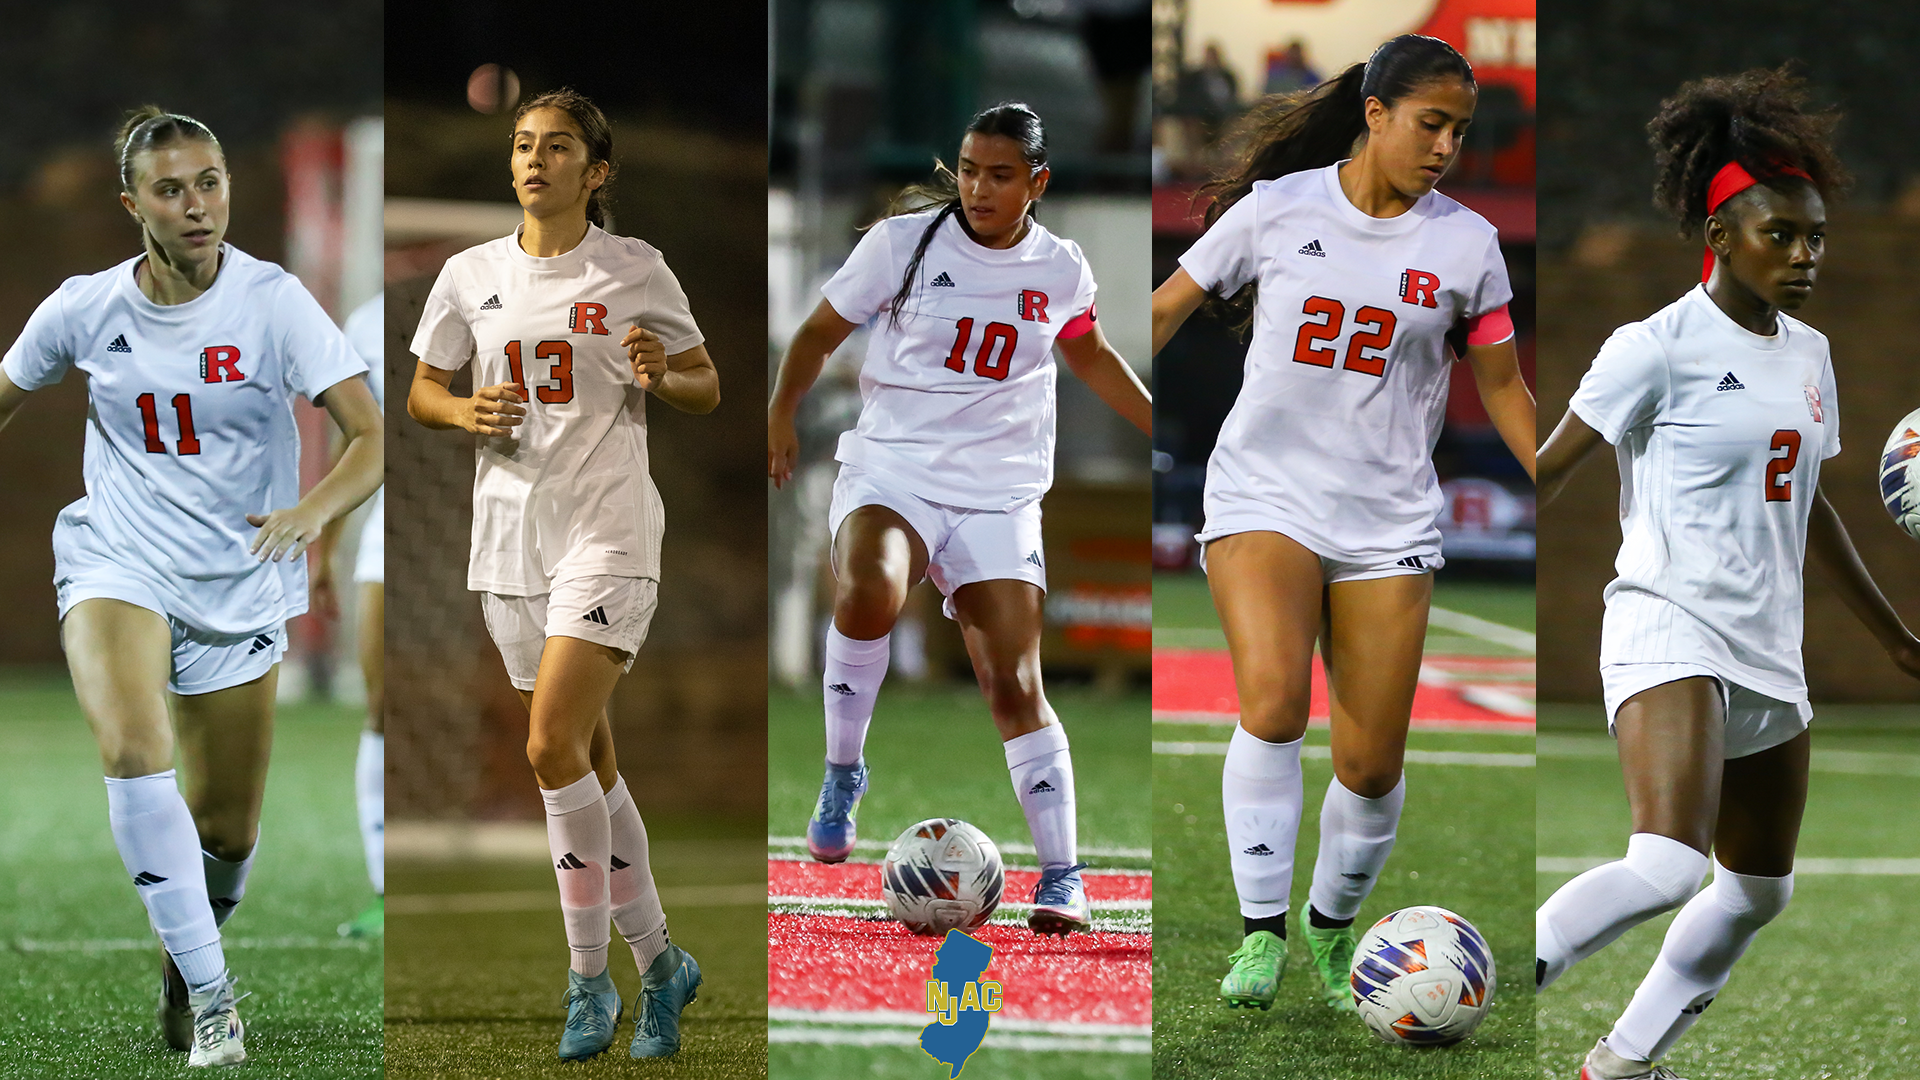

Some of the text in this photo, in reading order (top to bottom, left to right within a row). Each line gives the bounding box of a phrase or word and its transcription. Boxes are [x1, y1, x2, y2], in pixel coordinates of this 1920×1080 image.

[1298, 248, 1326, 258] adidas
[480, 303, 503, 311] adidas
[1021, 289, 1050, 324] R
[1402, 268, 1440, 309] R
[572, 302, 609, 336] R
[1292, 295, 1397, 378] 22
[106, 345, 132, 353] adidas
[204, 345, 245, 384] R
[944, 316, 1018, 382] 10
[504, 340, 574, 404] 13
[1717, 382, 1745, 392] adidas
[135, 392, 201, 456] 11
[1765, 429, 1802, 502] 2
